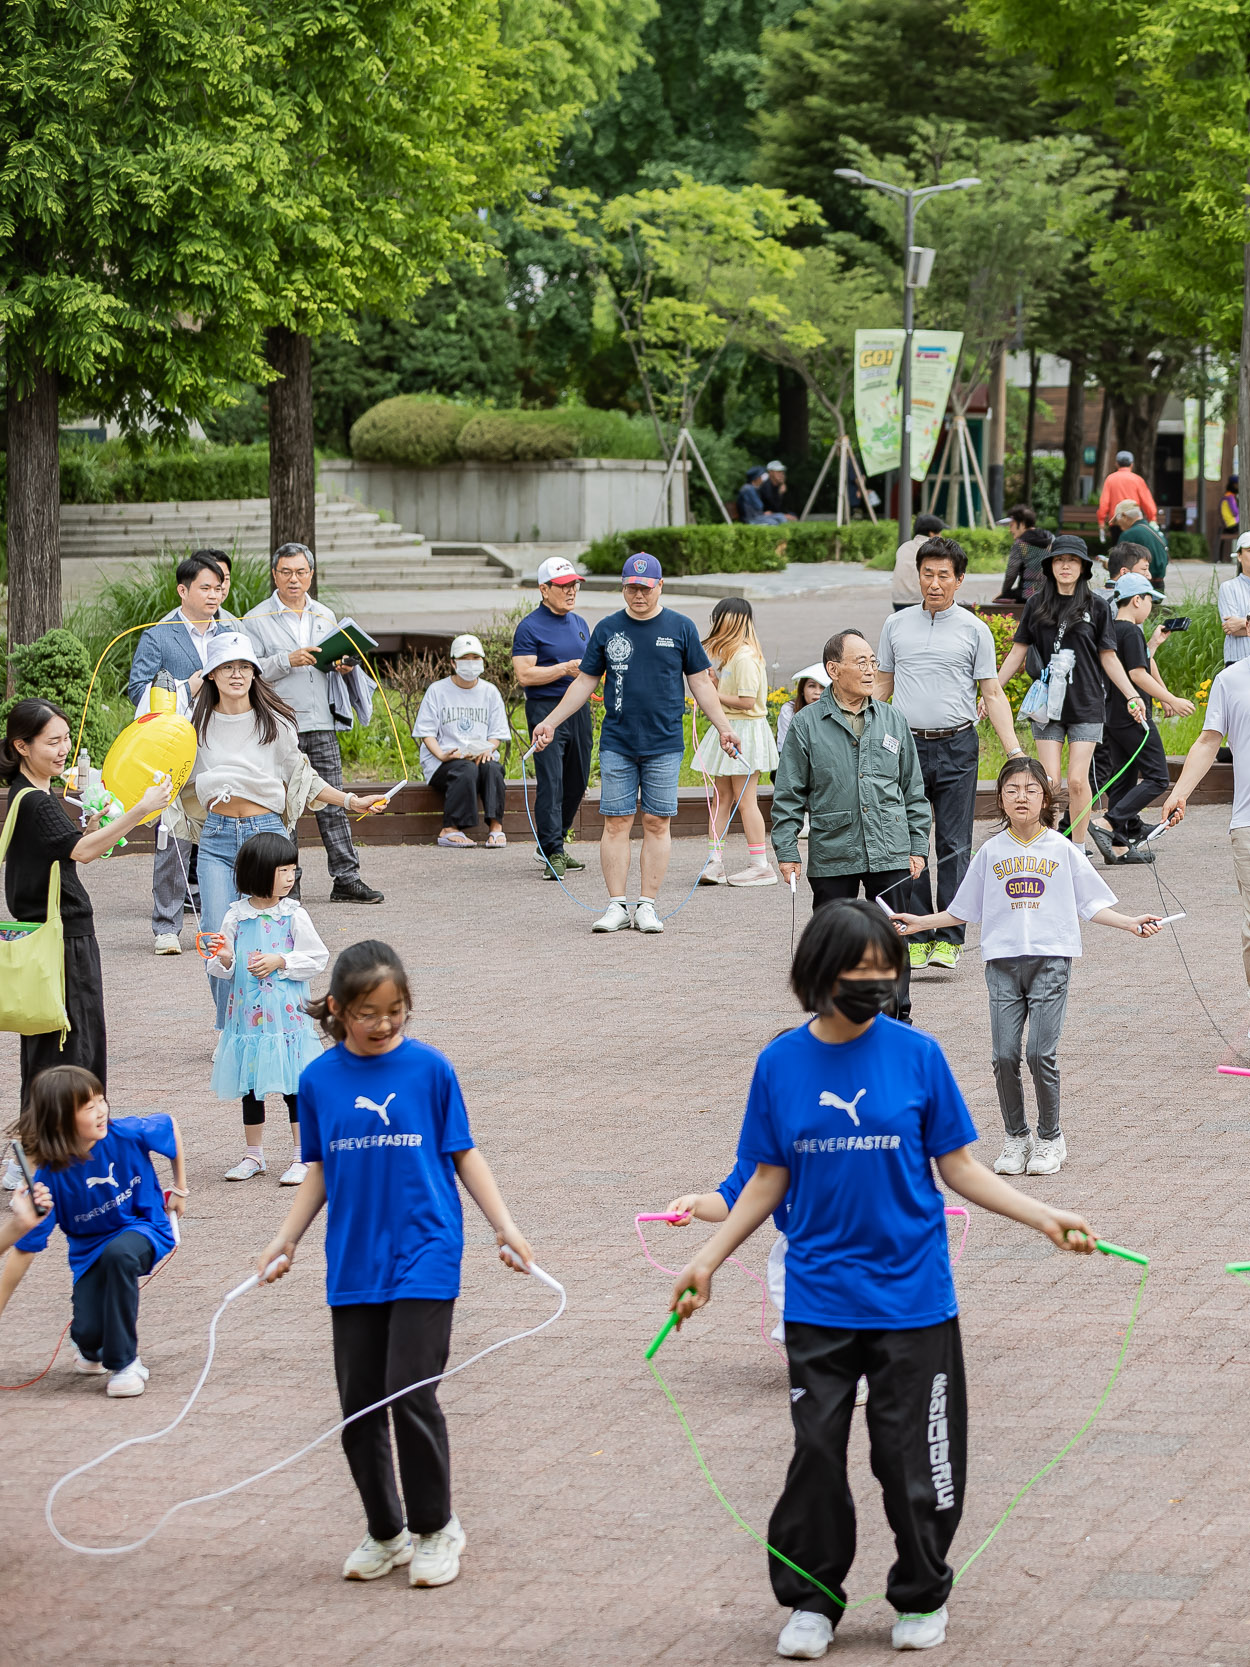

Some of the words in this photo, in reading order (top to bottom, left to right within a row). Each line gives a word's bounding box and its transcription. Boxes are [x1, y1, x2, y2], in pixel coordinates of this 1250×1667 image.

[860, 349, 894, 369] GO!
[441, 707, 488, 726] CALIFORNIA
[993, 856, 1059, 880] SUNDAY
[1008, 881, 1041, 895] SOCIAL
